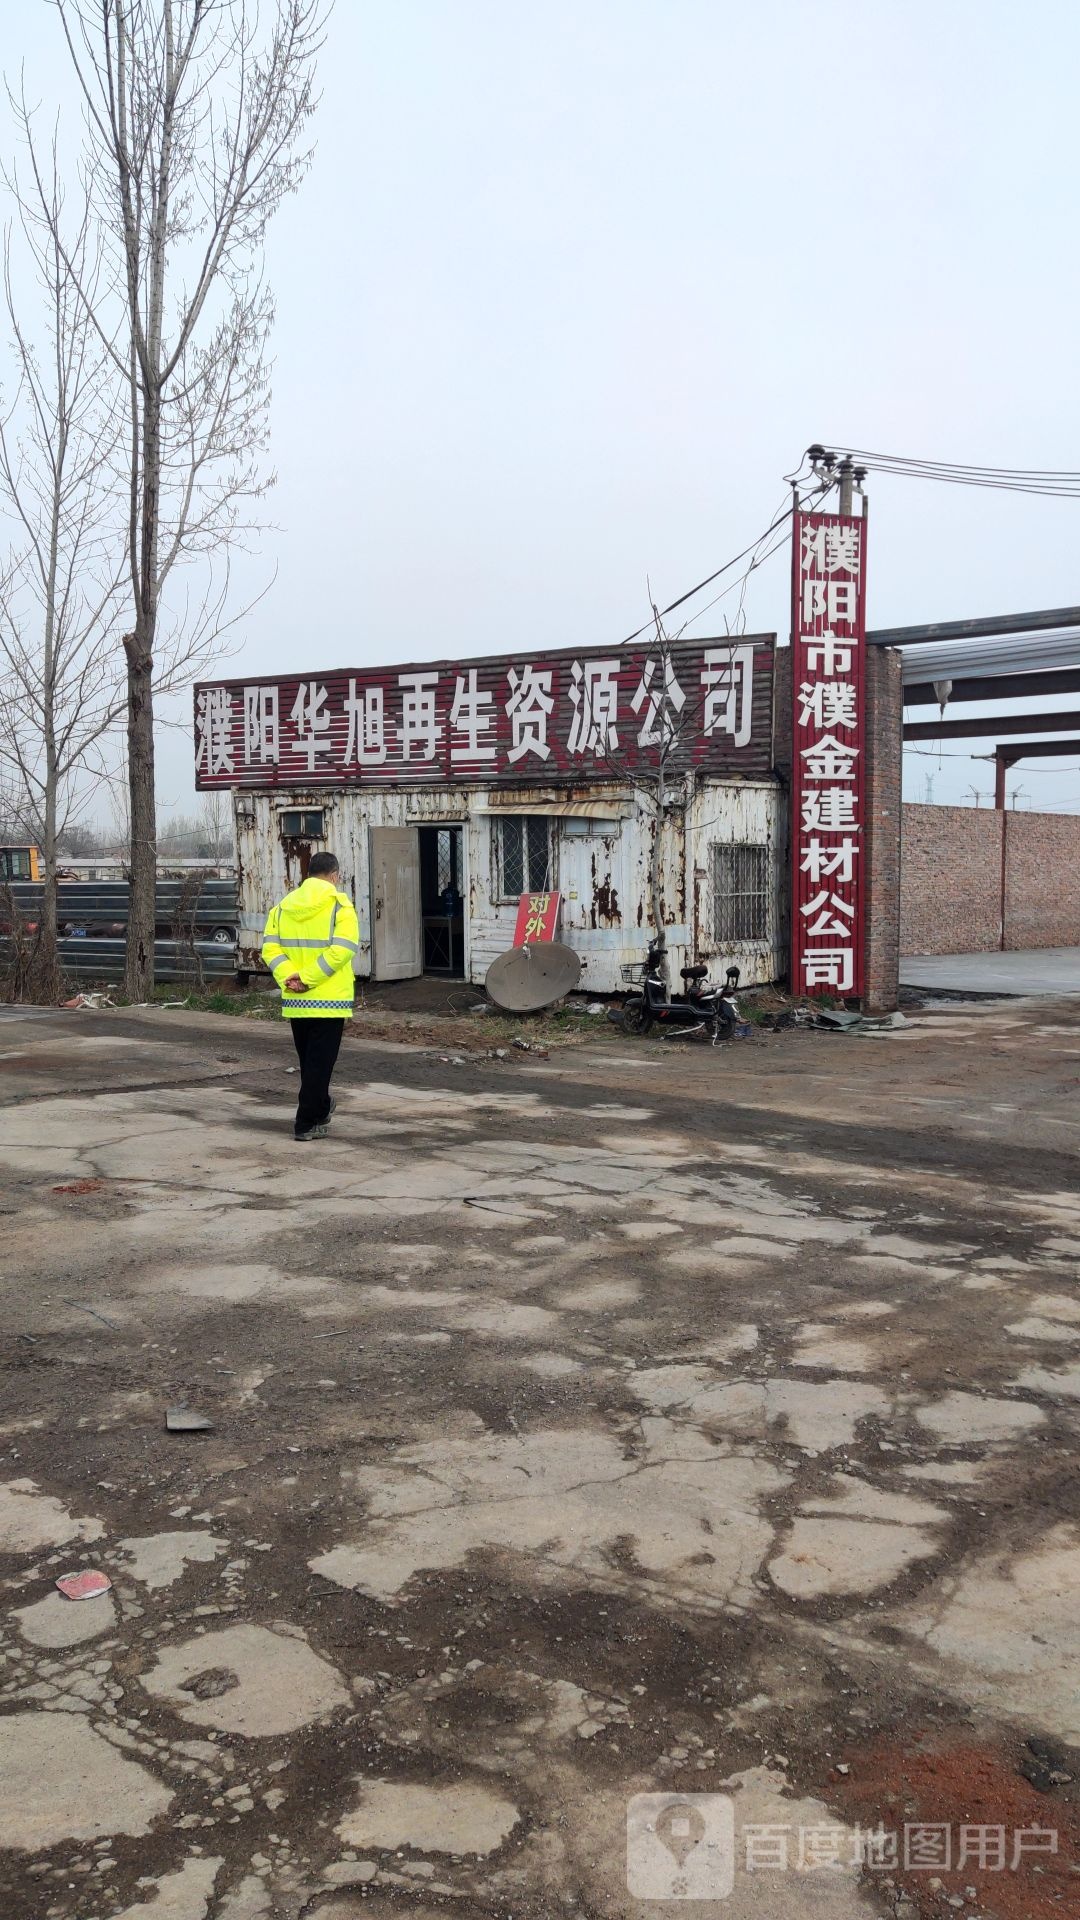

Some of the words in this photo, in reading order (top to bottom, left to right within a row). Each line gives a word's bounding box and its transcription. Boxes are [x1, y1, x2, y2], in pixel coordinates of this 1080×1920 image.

[195, 646, 754, 775] 濮阳华旭再生资源公司
[798, 524, 860, 992] 濮阳市濮金建材公司
